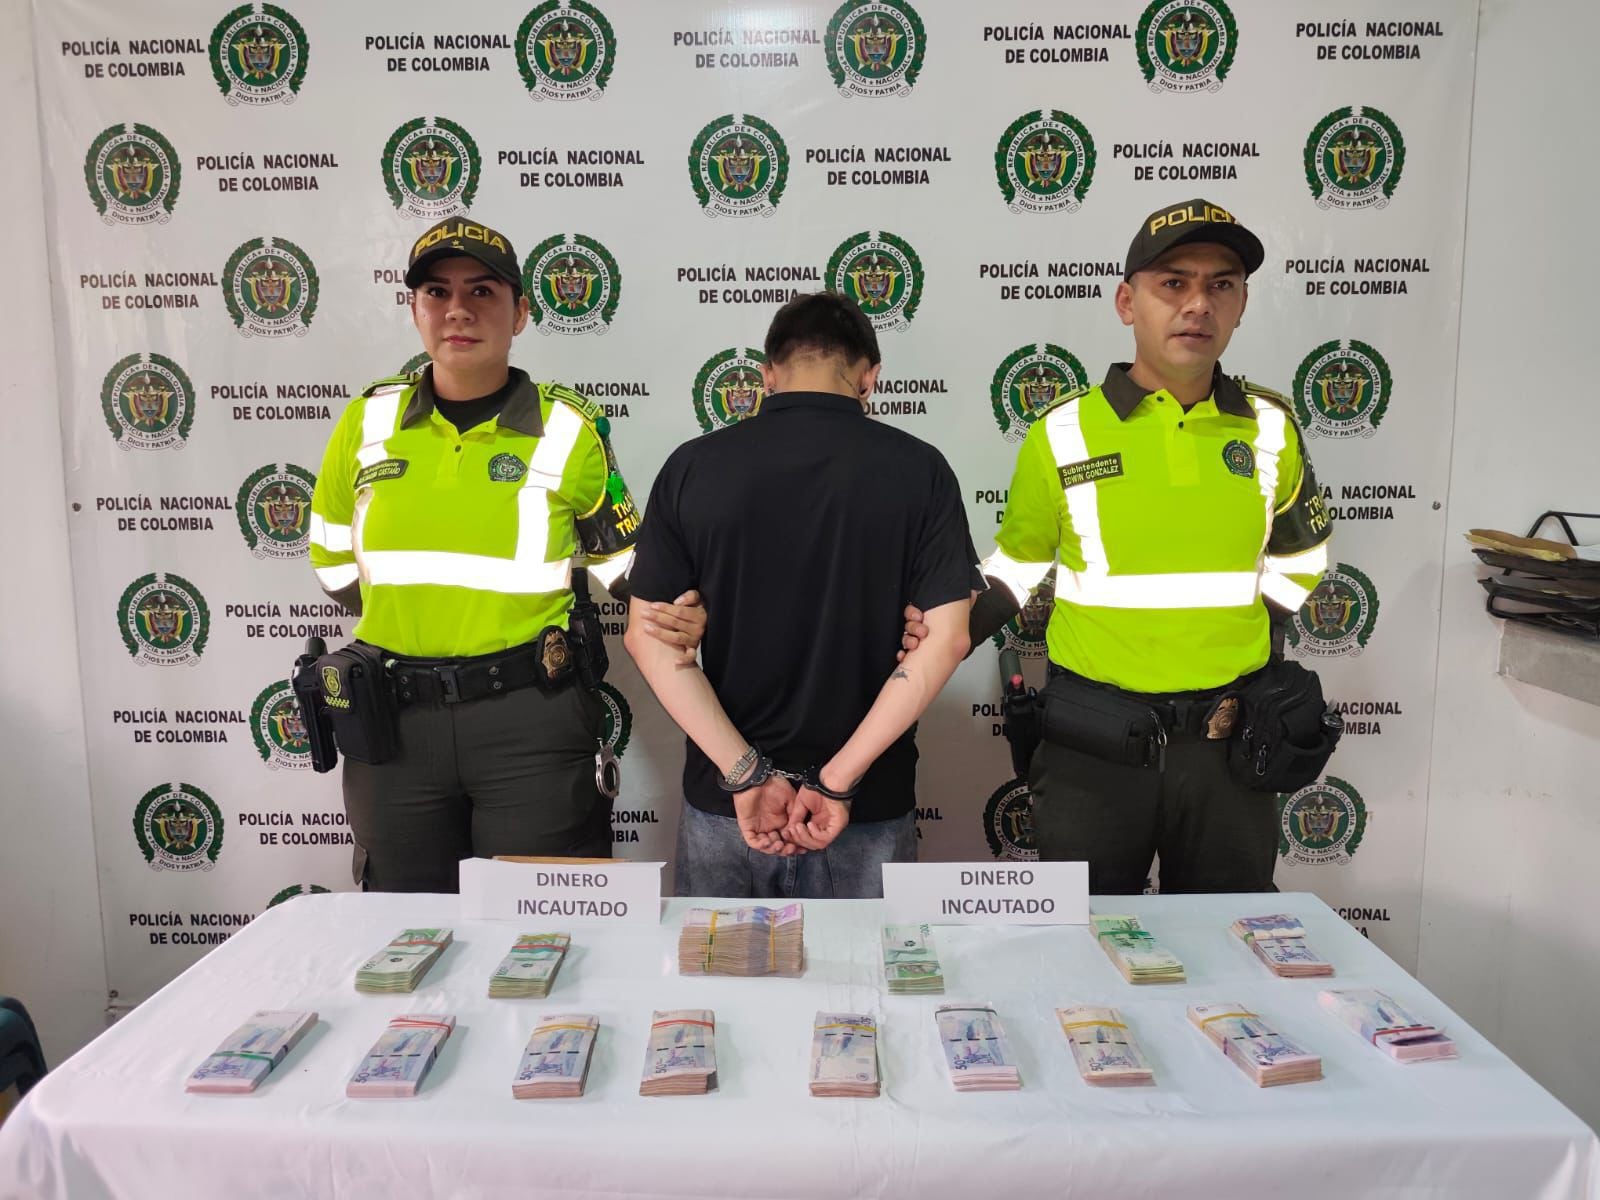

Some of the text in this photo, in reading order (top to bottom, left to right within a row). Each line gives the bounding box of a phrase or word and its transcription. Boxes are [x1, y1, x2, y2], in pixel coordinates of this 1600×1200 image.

[984, 23, 1131, 41] POLICÍA NACIONAL
[1296, 19, 1443, 37] POLICÍA NACIONAL
[366, 32, 511, 50] POLICÍA NACIONAL
[674, 28, 820, 46] POLICÍA NACIONAL
[62, 38, 205, 56] POLICÍA NACIONAL
[1317, 45, 1420, 60] DE COLOMBIA
[696, 53, 799, 68] DE COLOMBIA
[1006, 48, 1108, 63] DE COLOMBIA
[85, 62, 185, 78] DE COLOMBIA
[388, 57, 489, 71] DE COLOMBIA
[499, 147, 644, 165] POLICÍA NACIONAL
[806, 145, 951, 163] POLICÍA NACIONAL
[1114, 140, 1259, 158] POLICÍA NACIONAL
[197, 152, 338, 170] POLICÍA NACIONAL
[521, 173, 623, 187] DE COLOMBIA
[828, 170, 929, 185] DE COLOMBIA
[1135, 165, 1237, 180] DE COLOMBIA
[219, 176, 318, 191] DE COLOMBIA
[980, 260, 1123, 278] POLICÍA NACIONAL
[1286, 256, 1429, 273] POLICÍA NACIONAL
[80, 271, 218, 288] POLICÍA NACIONAL
[374, 270, 406, 283] POLI
[678, 264, 820, 281] POLICÍA NACIONAL
[1001, 285, 1102, 299] DE COLOMBIA
[1306, 281, 1407, 295] DE COLOMBIA
[103, 295, 199, 309] DE COLOMBIA
[700, 289, 798, 303] DE COLOMBIA
[211, 383, 350, 399] POLICÍA NACIONAL
[874, 379, 948, 394] NACIONAL
[233, 406, 331, 420] DE COLOMBIA
[864, 401, 926, 415] OLOMBIA
[1063, 474, 1084, 486] EDWIN
[976, 490, 1008, 503] POLI
[1342, 486, 1415, 499] NACIONAL
[97, 494, 232, 510] POLICÍA NACIONAL
[1328, 507, 1393, 520] OLOMBIA
[118, 518, 213, 530] DE COLOMBIA
[226, 601, 354, 617] POLICÍA NACIONA
[247, 625, 343, 637] DE COLOMBIA
[114, 708, 246, 723] POLICÍA NACIONAL
[973, 704, 1003, 716] POLI
[1346, 722, 1381, 734] MBIA
[135, 730, 227, 743] DE COLOMBIA
[239, 811, 348, 825] POLICÍA NACIO
[611, 811, 659, 823] CIONAL
[260, 832, 354, 844] DE COLOMBIA
[537, 872, 608, 887] DINERO
[960, 870, 1034, 885] DINERO
[517, 899, 628, 917] INCAUTADO
[942, 899, 1055, 914] INCAUTADO
[1338, 908, 1390, 920] CIONAL
[130, 912, 183, 926] POLICÍA
[150, 932, 231, 944] DE COLOMB
